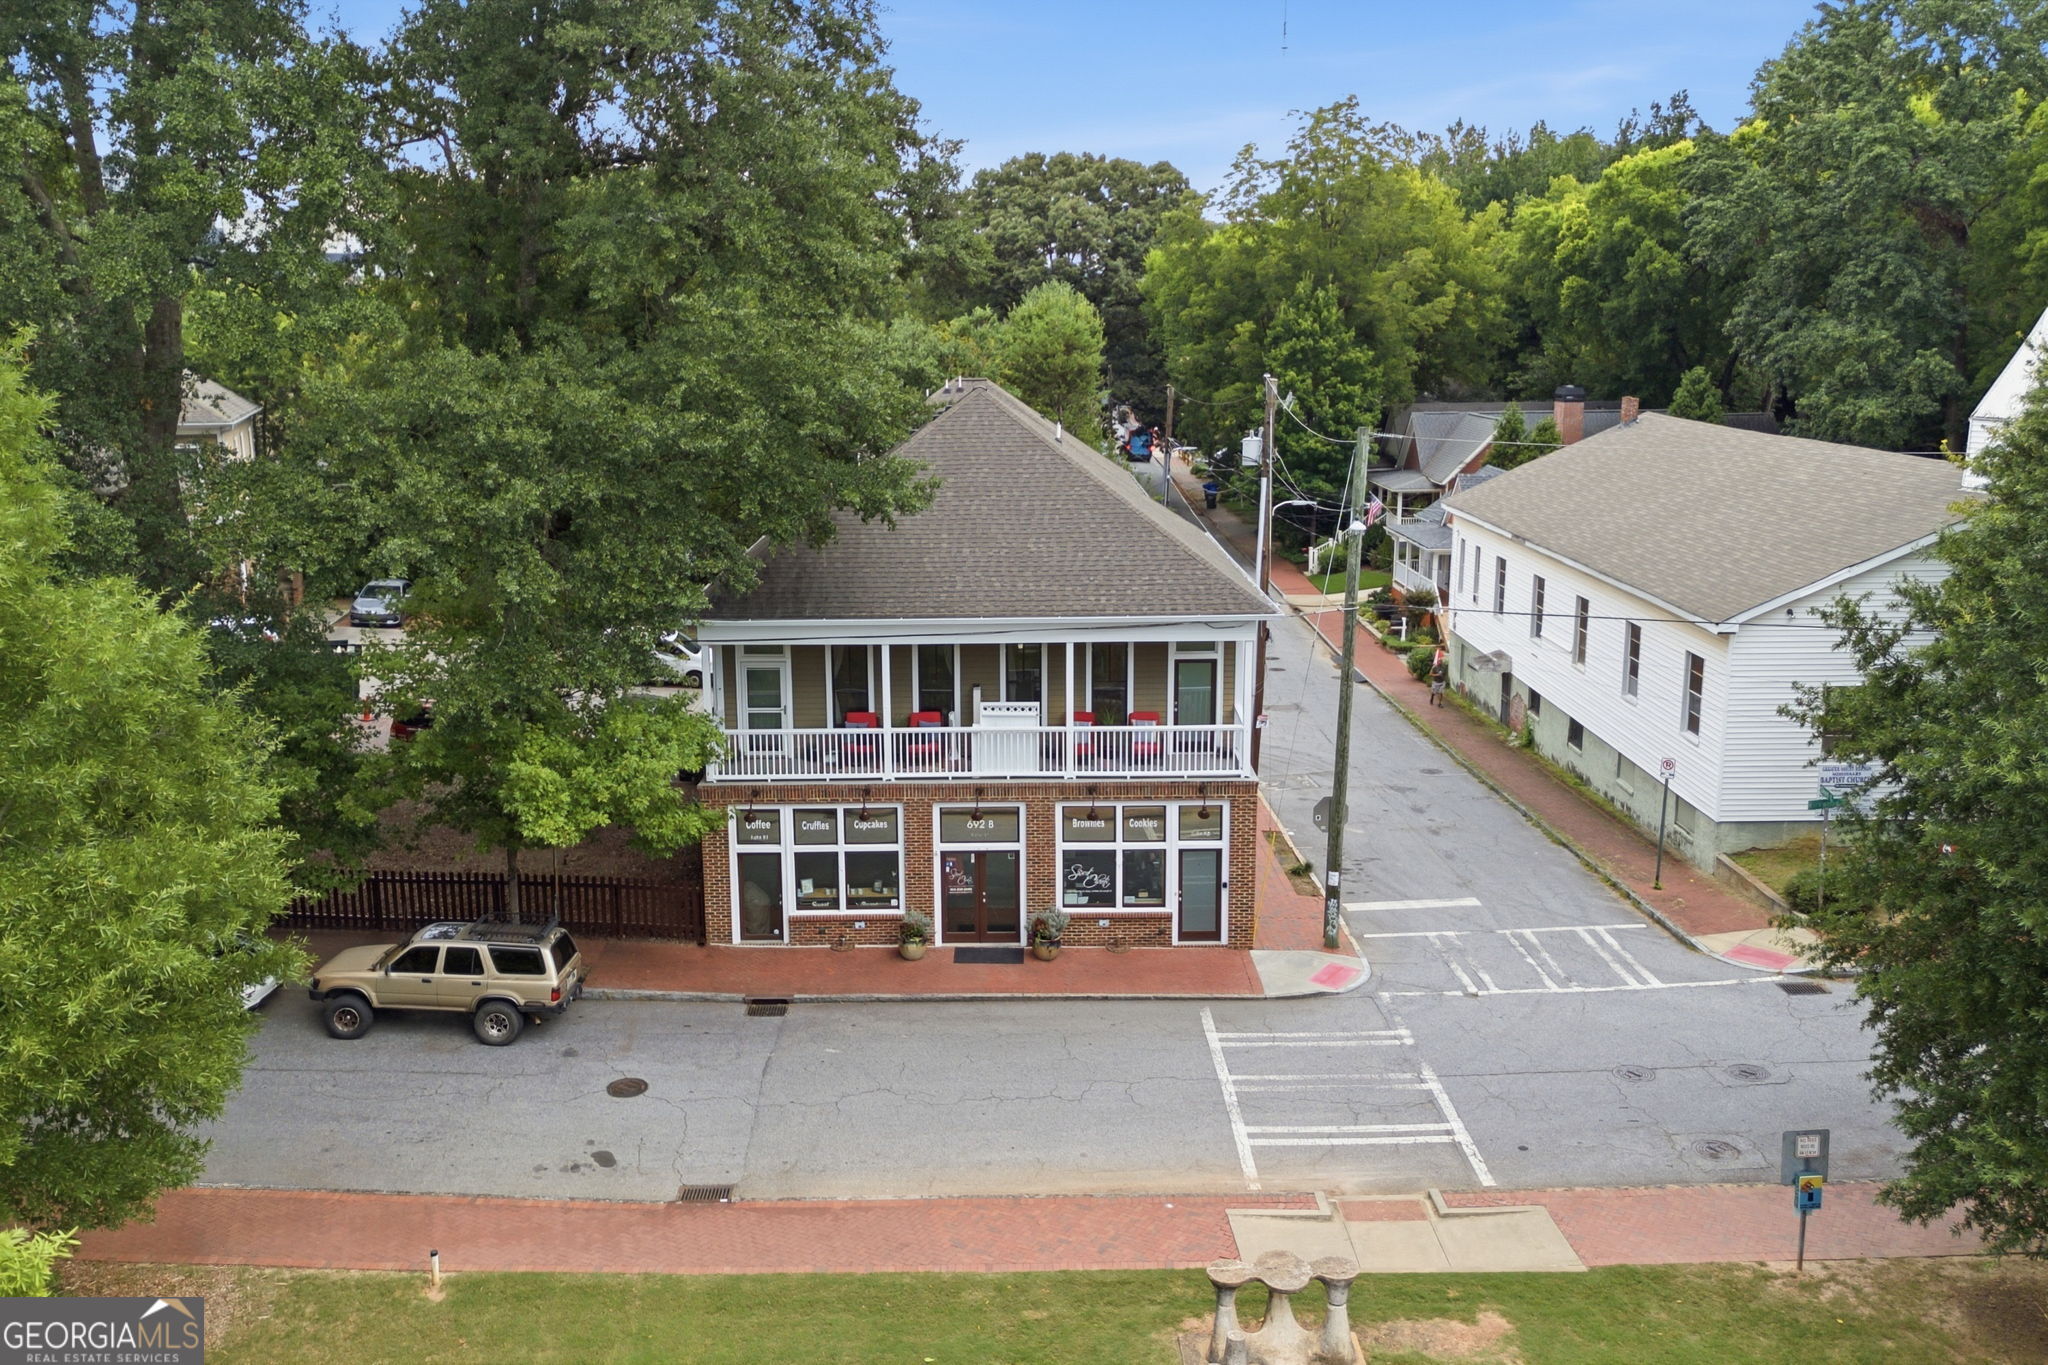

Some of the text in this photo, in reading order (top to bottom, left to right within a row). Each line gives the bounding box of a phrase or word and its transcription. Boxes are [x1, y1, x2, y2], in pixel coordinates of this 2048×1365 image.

[745, 819, 772, 829] Coffee
[801, 820, 830, 831] Cruffles
[853, 819, 888, 831] Cupcakes
[966, 819, 986, 829] 692
[1072, 818, 1105, 828] Brownies
[1128, 817, 1158, 828] Cookies
